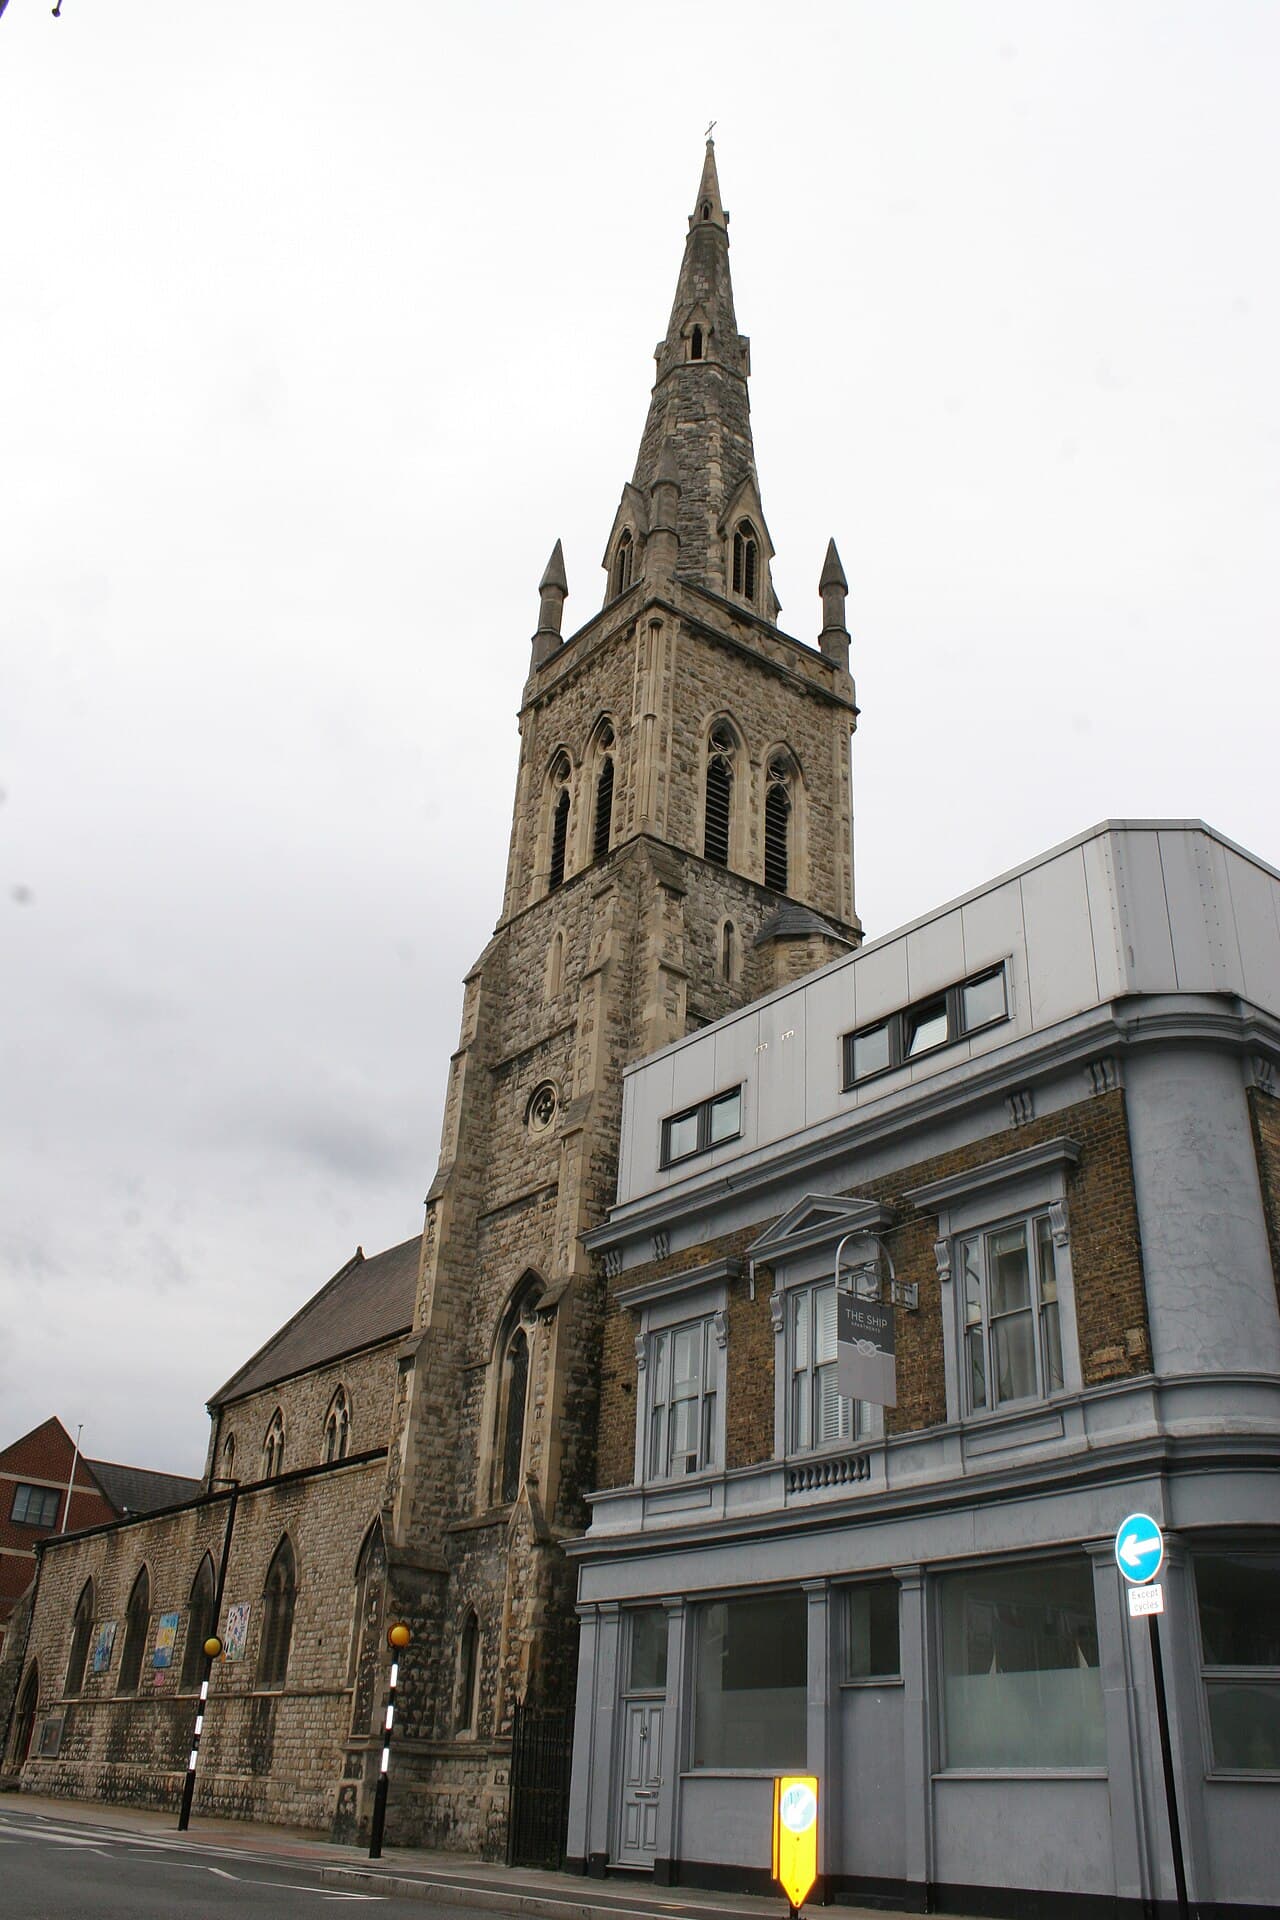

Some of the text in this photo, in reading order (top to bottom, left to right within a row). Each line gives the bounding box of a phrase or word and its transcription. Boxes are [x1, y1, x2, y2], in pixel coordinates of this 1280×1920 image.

[845, 1308, 888, 1329] THE SHIP
[1131, 1588, 1159, 1600] Except
[1133, 1600, 1159, 1612] cycles
